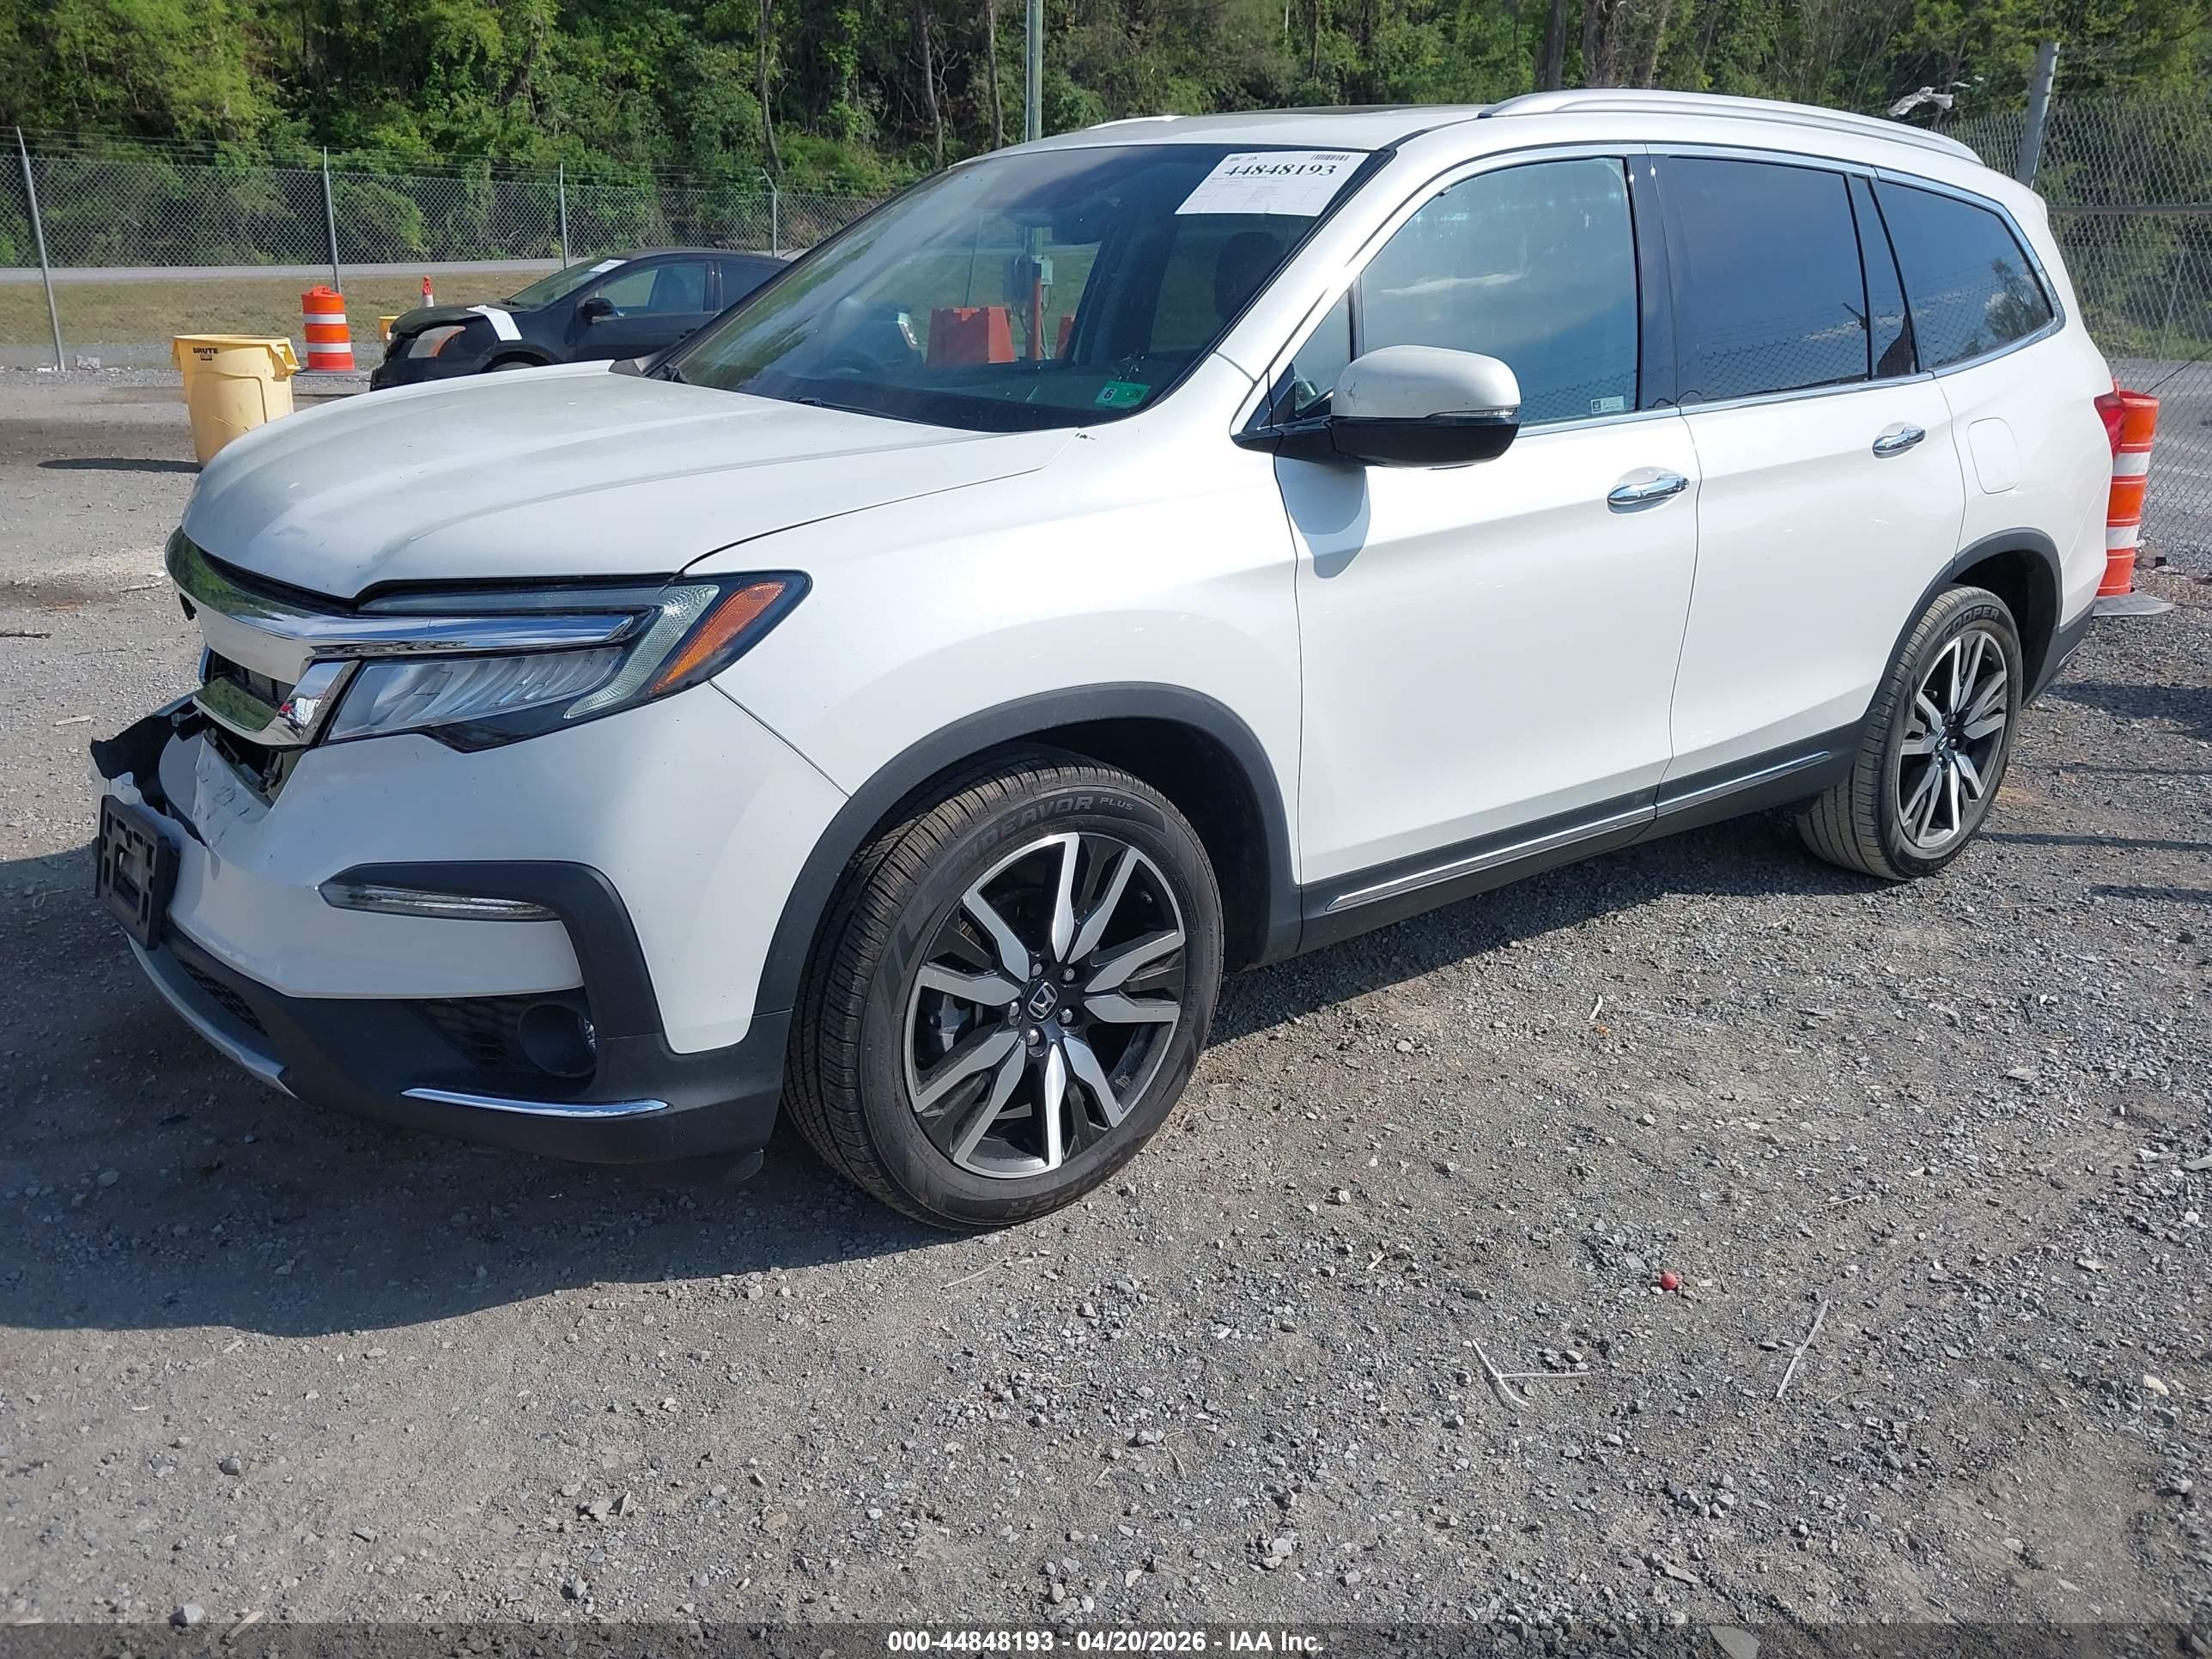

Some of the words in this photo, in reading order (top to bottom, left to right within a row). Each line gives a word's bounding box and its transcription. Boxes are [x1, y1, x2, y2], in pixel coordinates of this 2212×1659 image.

[1224, 164, 1337, 176] 44848193
[1104, 388, 1115, 399] 6
[1942, 605, 2000, 642] COOPER
[1099, 796, 1134, 811] PLUS
